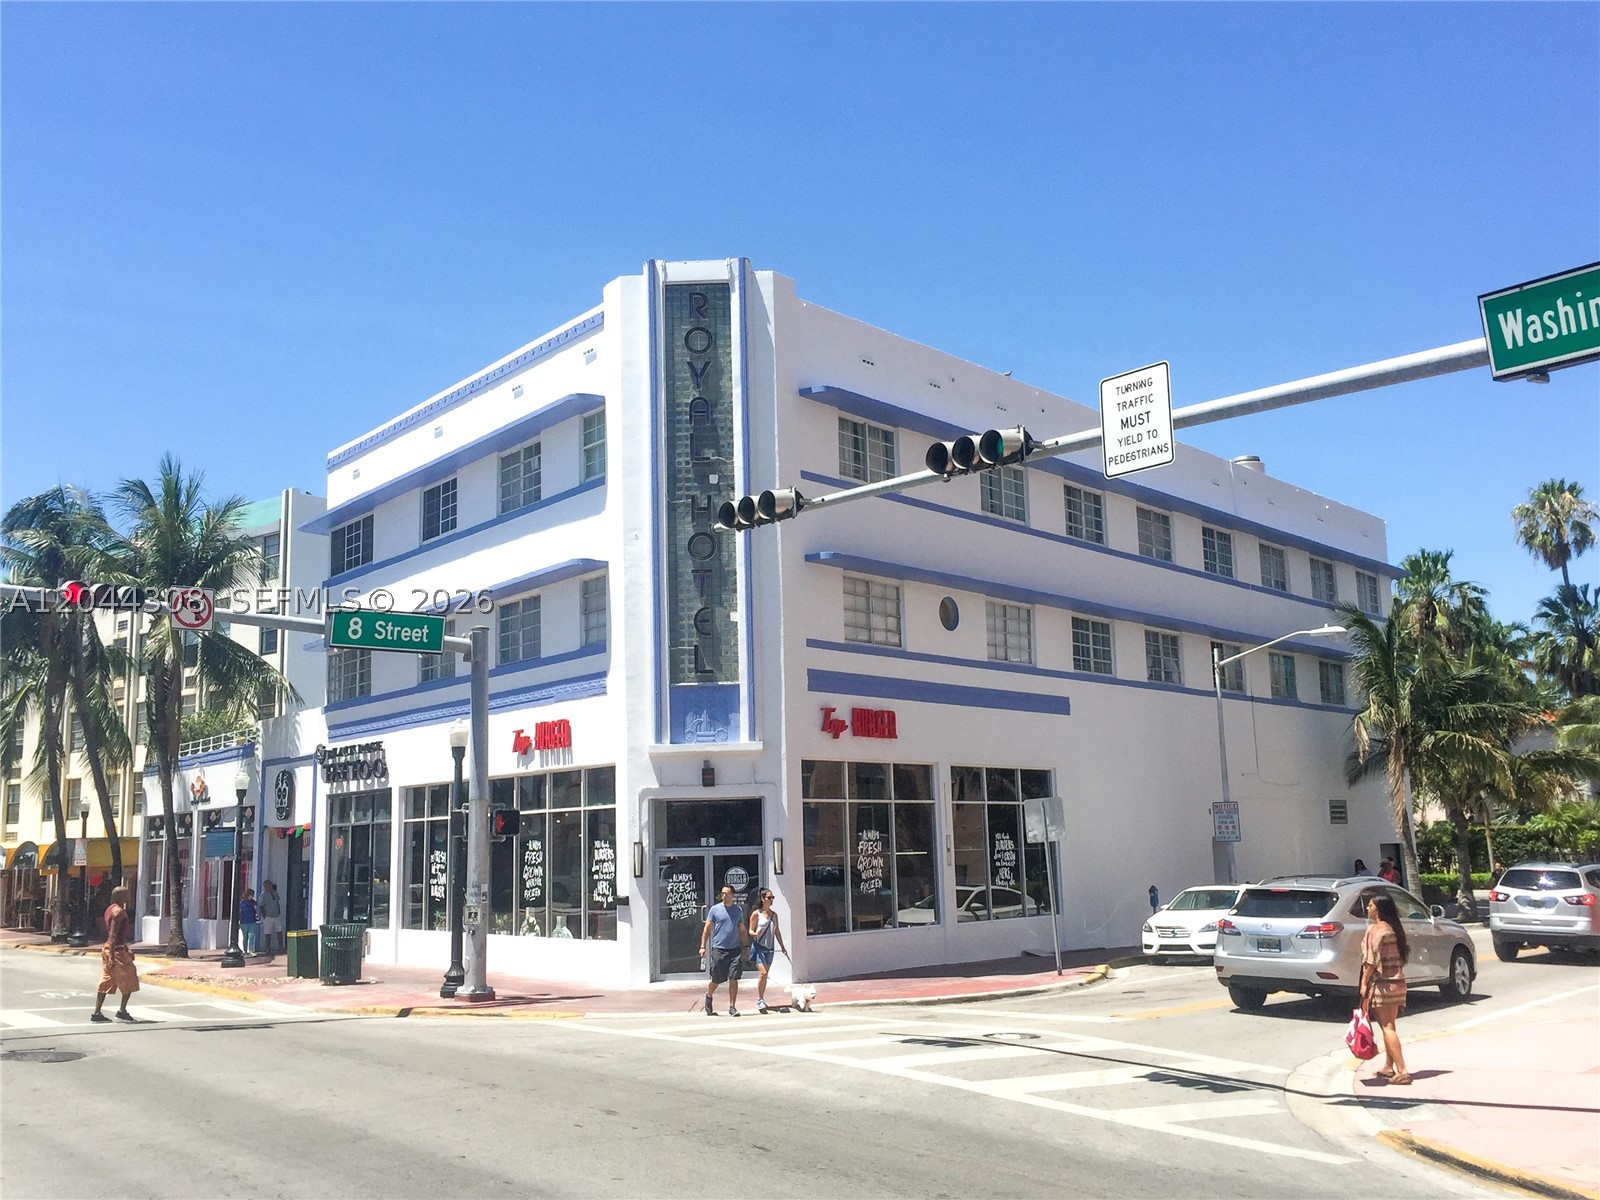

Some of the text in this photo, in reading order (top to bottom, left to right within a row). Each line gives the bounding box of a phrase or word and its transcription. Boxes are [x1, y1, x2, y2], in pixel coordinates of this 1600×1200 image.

[684, 292, 713, 462] ROYAL
[1115, 377, 1153, 396] TURNING
[1116, 393, 1154, 412] TRAFFIC
[1120, 410, 1151, 431] MUST
[1117, 428, 1158, 448] YIELD TO
[1108, 442, 1169, 467] PEDESTRIANS
[687, 494, 717, 674] HOTEL
[347, 617, 429, 643] 8 Street
[1214, 803, 1237, 811] NOTICE
[857, 840, 882, 856] FRESH
[857, 855, 884, 872] GROWN
[667, 881, 696, 894] FRESH
[666, 891, 697, 905] GROWN
[670, 907, 697, 920] FROZEN
